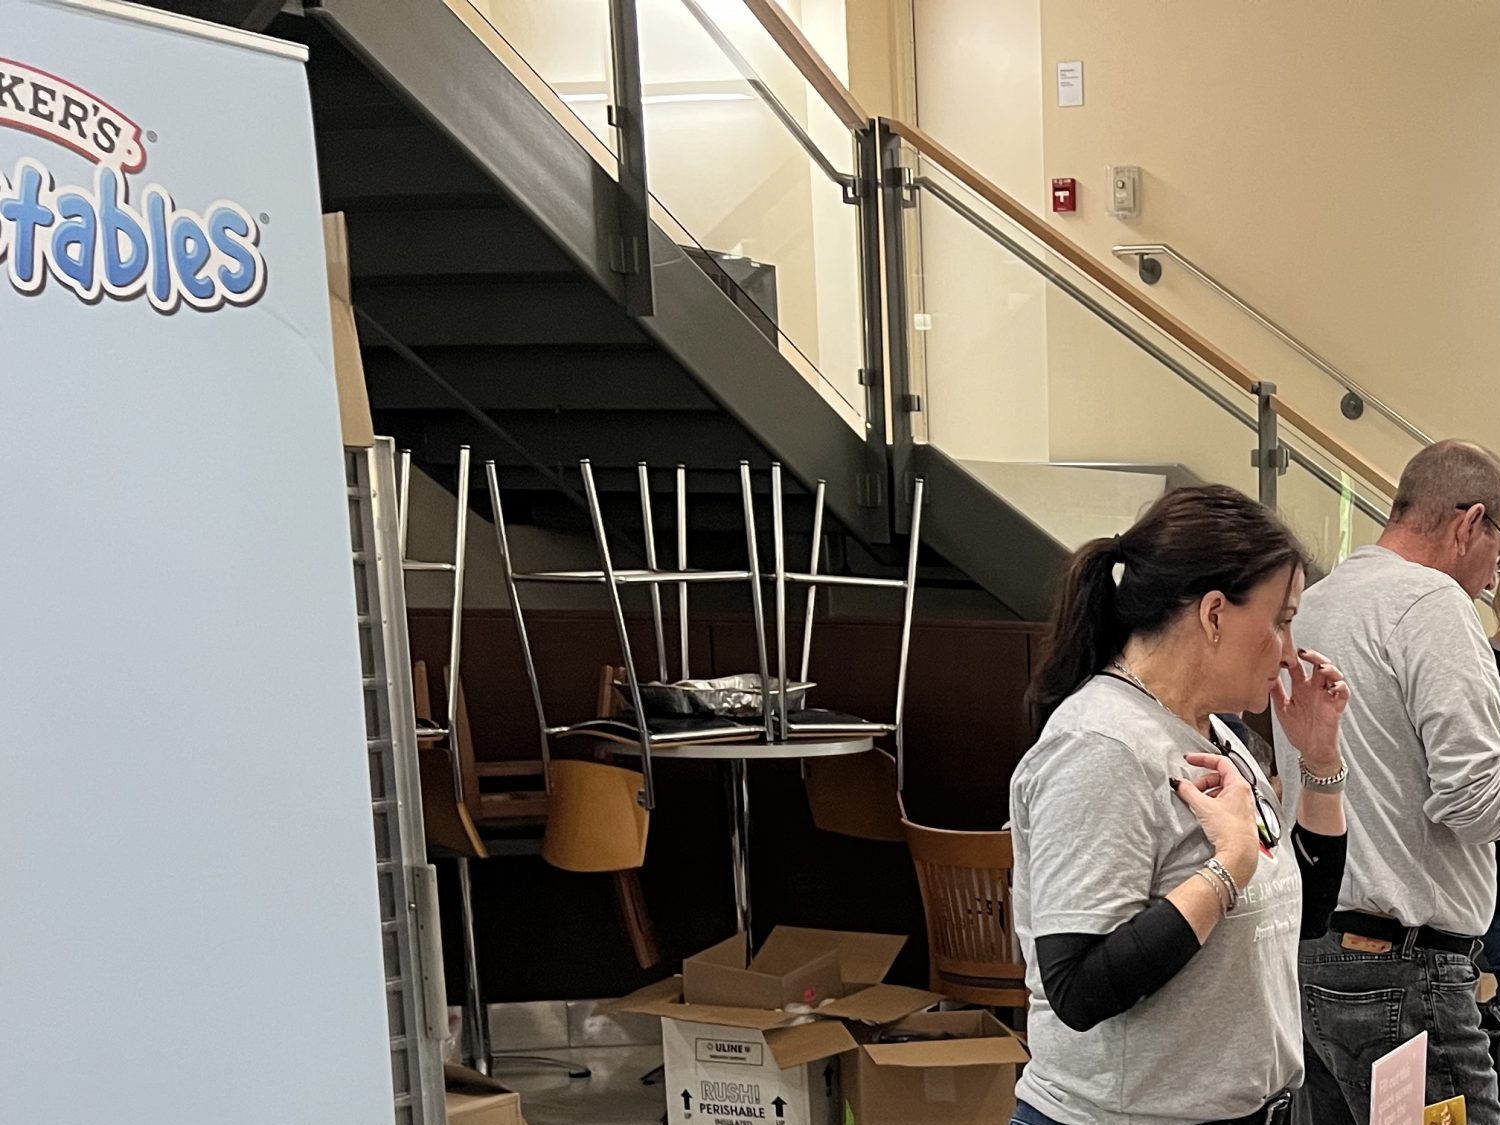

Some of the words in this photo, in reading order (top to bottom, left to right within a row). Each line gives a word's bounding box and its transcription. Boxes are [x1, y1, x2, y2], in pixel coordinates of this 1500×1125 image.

[715, 1043, 743, 1054] ULINE
[700, 1080, 760, 1104] RUSH!
[699, 1102, 765, 1119] PERISHABLE
